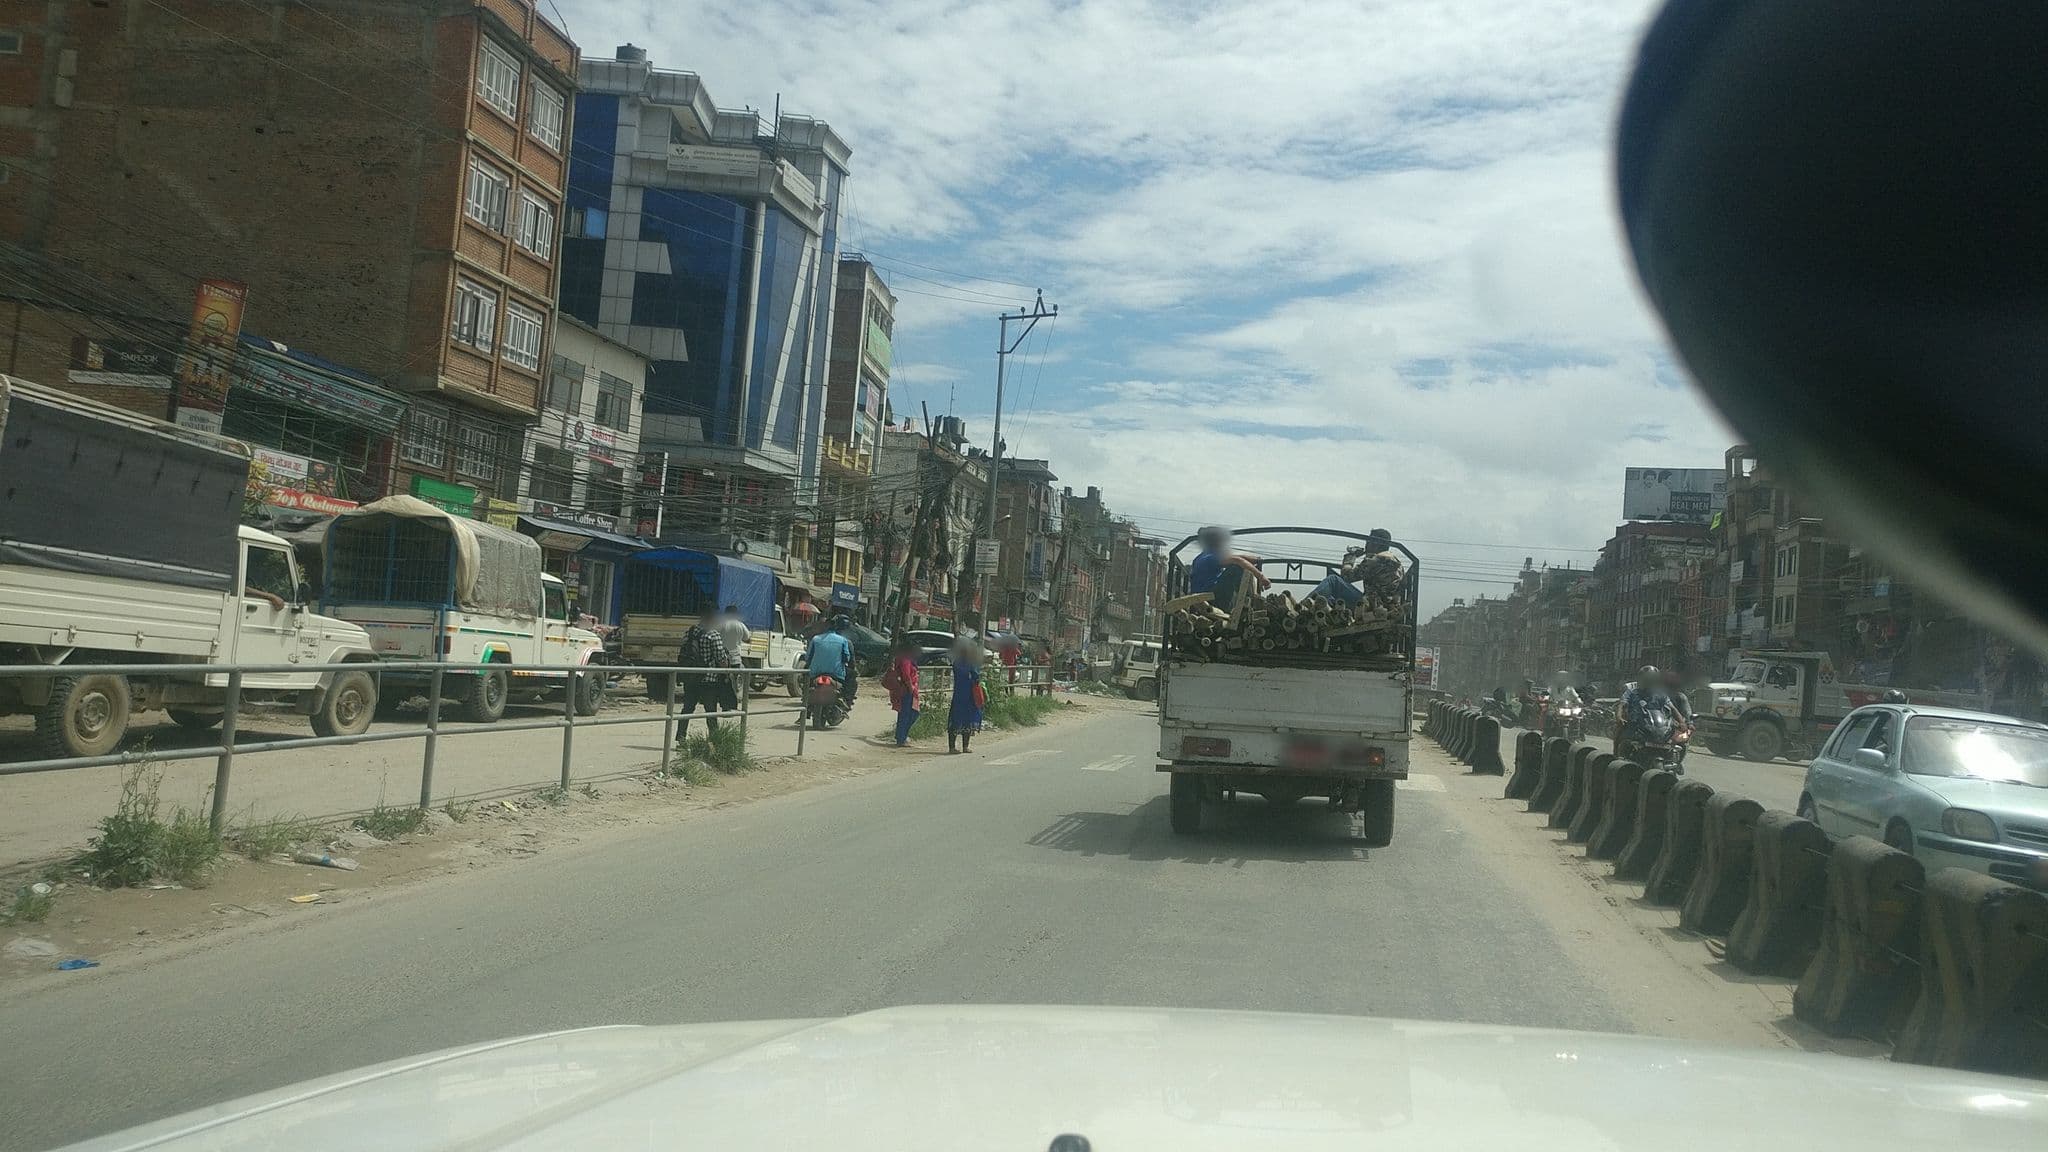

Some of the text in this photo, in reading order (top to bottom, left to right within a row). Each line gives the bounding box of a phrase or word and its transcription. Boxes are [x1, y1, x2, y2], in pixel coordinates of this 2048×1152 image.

[1671, 501, 1689, 510] REAL
[574, 512, 595, 525] Coffee
[597, 516, 613, 533] Shop
